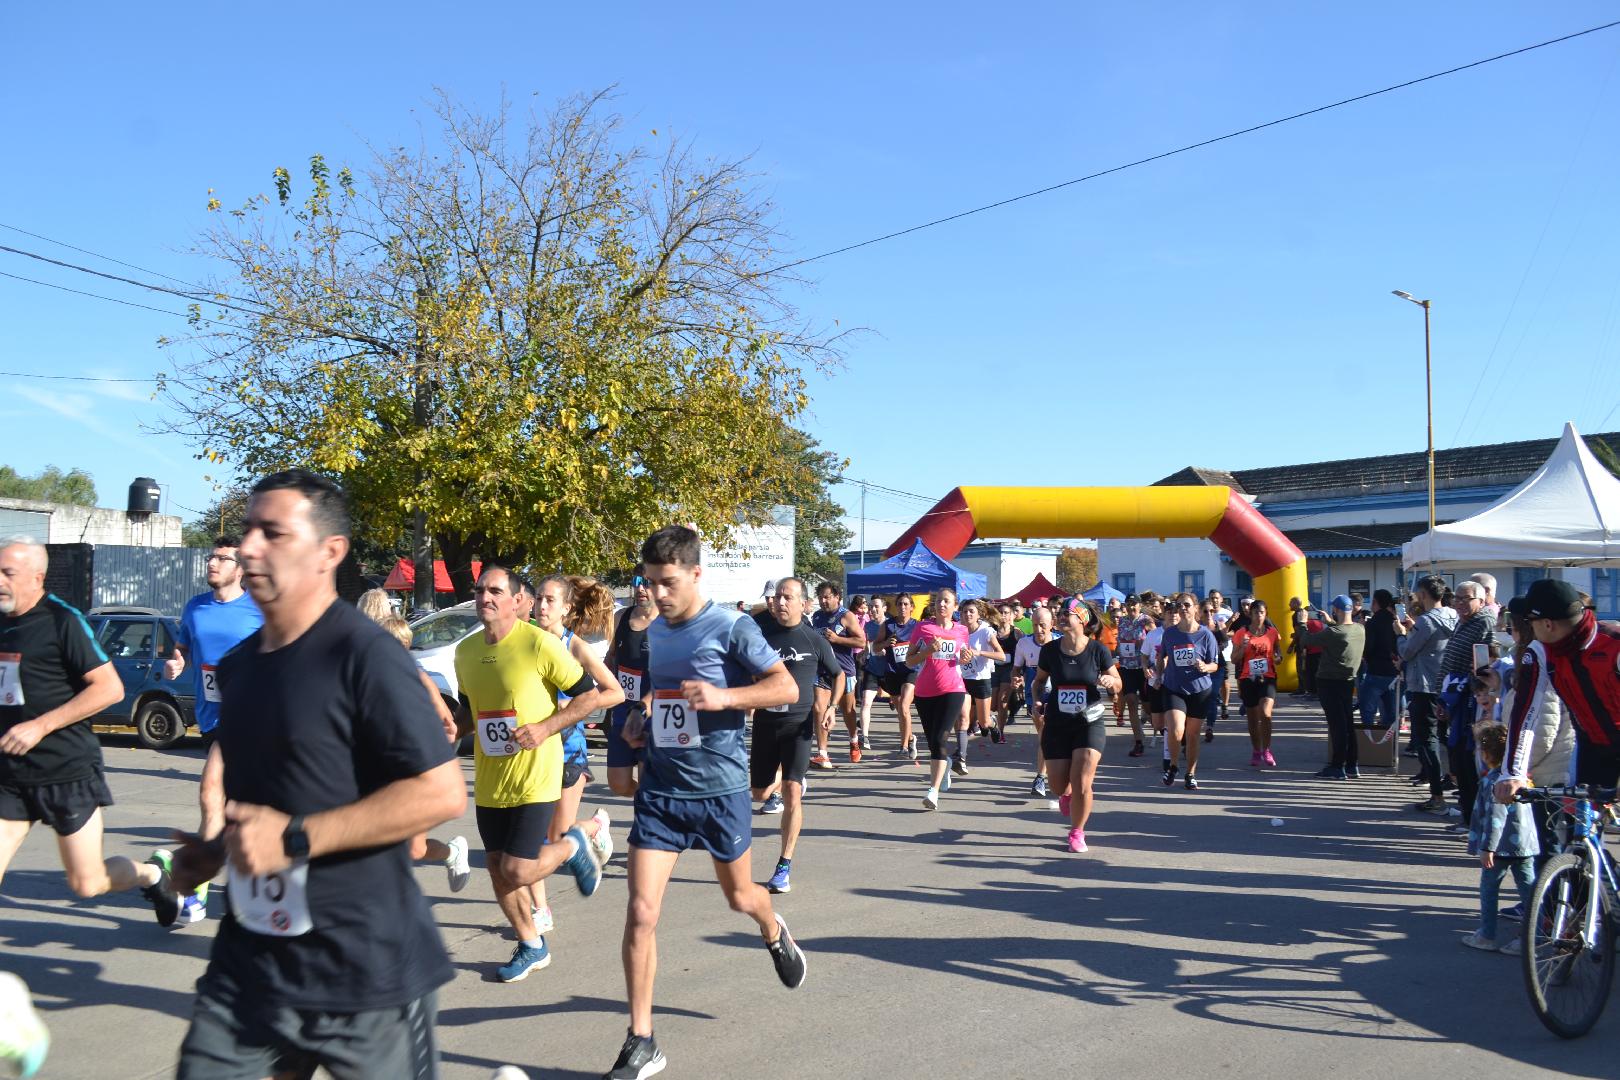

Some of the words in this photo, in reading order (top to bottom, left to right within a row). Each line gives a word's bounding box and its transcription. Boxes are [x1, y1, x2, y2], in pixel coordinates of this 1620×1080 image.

[707, 551, 742, 559] instalción
[753, 552, 784, 560] barreras
[938, 641, 954, 653] 00
[1175, 649, 1193, 660] 225
[1253, 660, 1264, 669] 35
[620, 675, 635, 691] 38
[1060, 691, 1084, 705] 226
[659, 704, 685, 729] 79
[486, 721, 510, 742] 63
